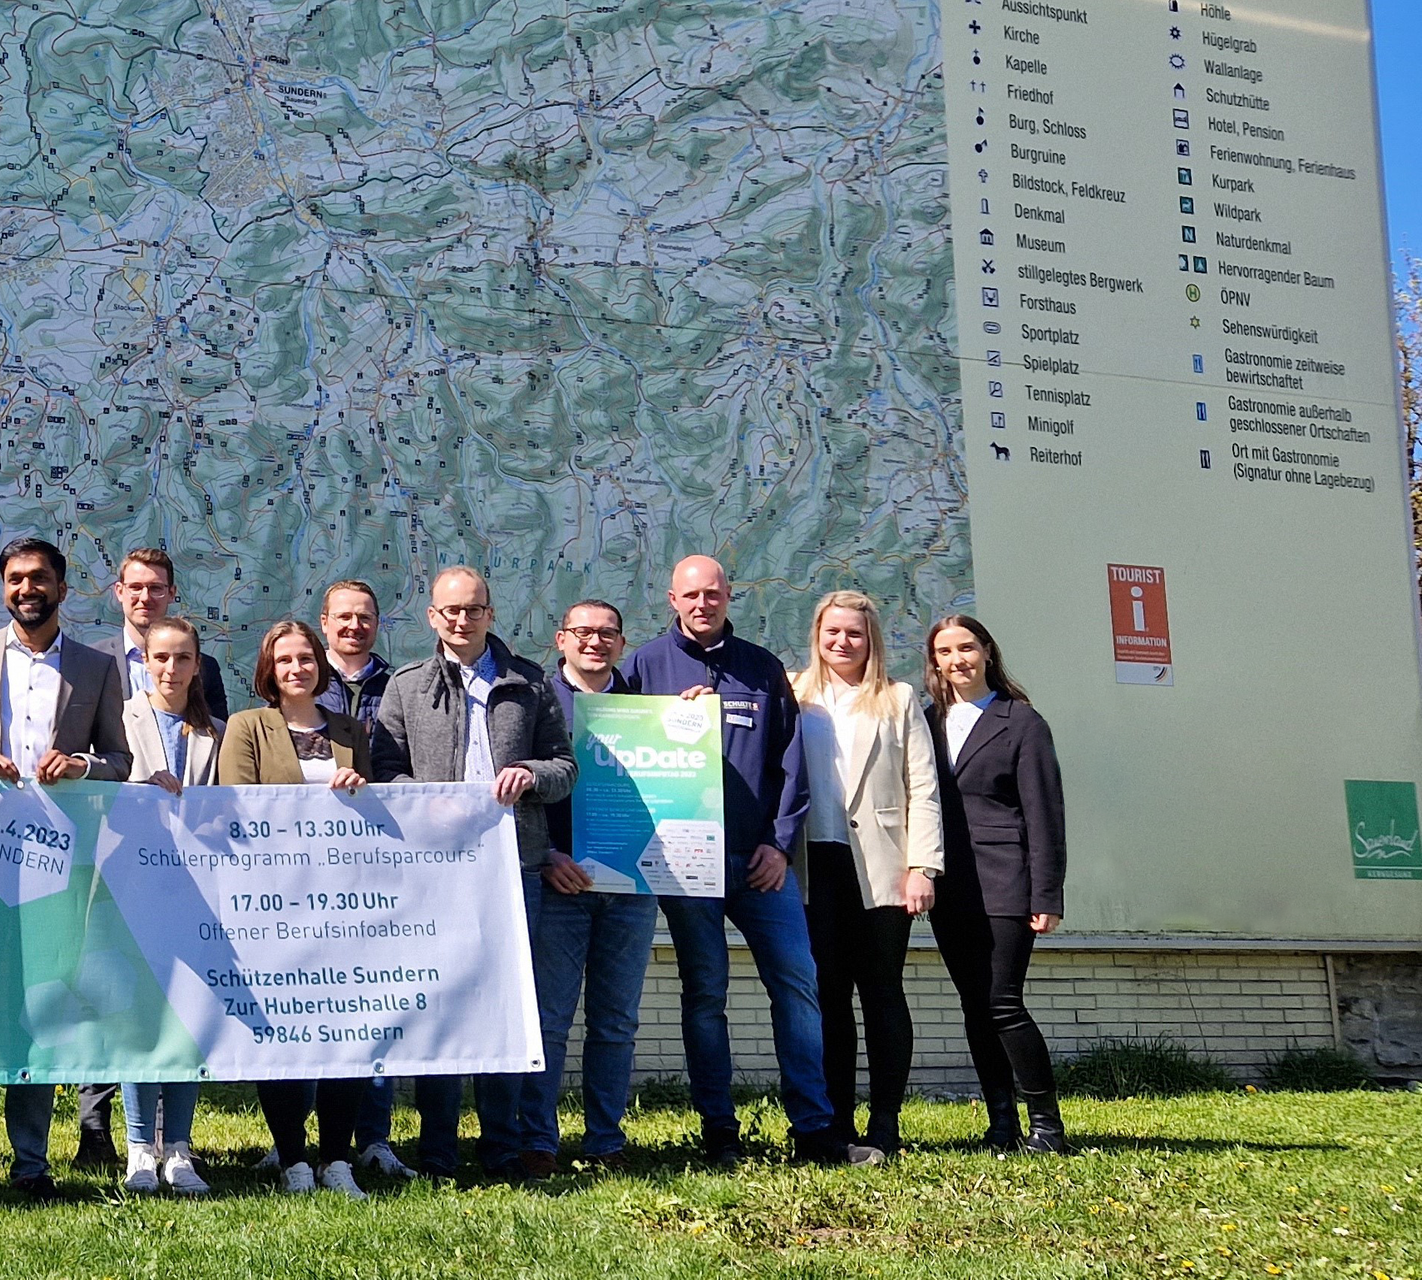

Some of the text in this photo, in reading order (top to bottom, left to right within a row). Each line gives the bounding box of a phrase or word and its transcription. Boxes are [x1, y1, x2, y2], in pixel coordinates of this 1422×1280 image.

[1002, 0, 1088, 24] Aussichtspunkt
[1200, 2, 1231, 21] Höhle
[1004, 26, 1040, 45] Kirche
[1202, 31, 1257, 54] Hügelgrab
[1006, 55, 1047, 76] Kapelle
[1204, 59, 1263, 82] Wallanlage
[278, 85, 323, 99] SUNDERN
[1007, 85, 1054, 105] Friedhof
[1206, 88, 1270, 111] Schutzhütte
[1009, 114, 1086, 140] Burg, Schloss
[1208, 116, 1285, 142] Hotel, Pension
[1011, 144, 1066, 166] Burgruine
[1210, 145, 1356, 180] Ferienwohnung, Ferienhaus
[1013, 174, 1126, 203] Bildstock, Feldkreuz
[1212, 174, 1255, 194] Kurpark
[1015, 203, 1065, 224] Denkmal
[1214, 203, 1262, 223] Wildpark
[1016, 233, 1066, 254] Museum
[1216, 232, 1292, 255] Naturdenkmal
[1018, 264, 1143, 294] stillgelegtes Bergwerk
[1218, 260, 1335, 289] Hervorragender Baum
[1020, 294, 1077, 315] Forsthaus
[1220, 286, 1251, 308] ÖPNV
[1021, 324, 1080, 345] Sportplatz
[1223, 319, 1319, 345] Sehenswürdigkeit
[1023, 354, 1080, 376] Spielplatz
[1224, 348, 1346, 376] Gastronomie zeitweise
[1226, 367, 1303, 391] bewirtschaftet
[1025, 385, 1091, 407] Tennisplatz
[1228, 395, 1352, 423] Gastronomie außerhalb
[1028, 415, 1074, 436] Minigolf
[1230, 415, 1371, 444] geschlossener Ortschaften
[1030, 446, 1082, 467] Reiterhof
[1232, 443, 1340, 469] Ort mit Gastronomie
[1234, 463, 1375, 493] (Signatur ohne Lagebezug)
[1110, 566, 1161, 584] TOURIST
[1116, 635, 1167, 647] INFORMATION
[594, 746, 706, 777] UpDate
[229, 819, 386, 839] 8.30 13.30 Uhr
[138, 847, 311, 871] Schülerprogramm
[230, 891, 398, 912] 17.00 19.30 Uhr
[198, 919, 437, 941] Offener Berufsinfoabend
[206, 965, 439, 988] Schützenhalle Sundern
[224, 993, 427, 1017] Zur Hubertushalle 8
[252, 1022, 404, 1045] 59846 Sundern
